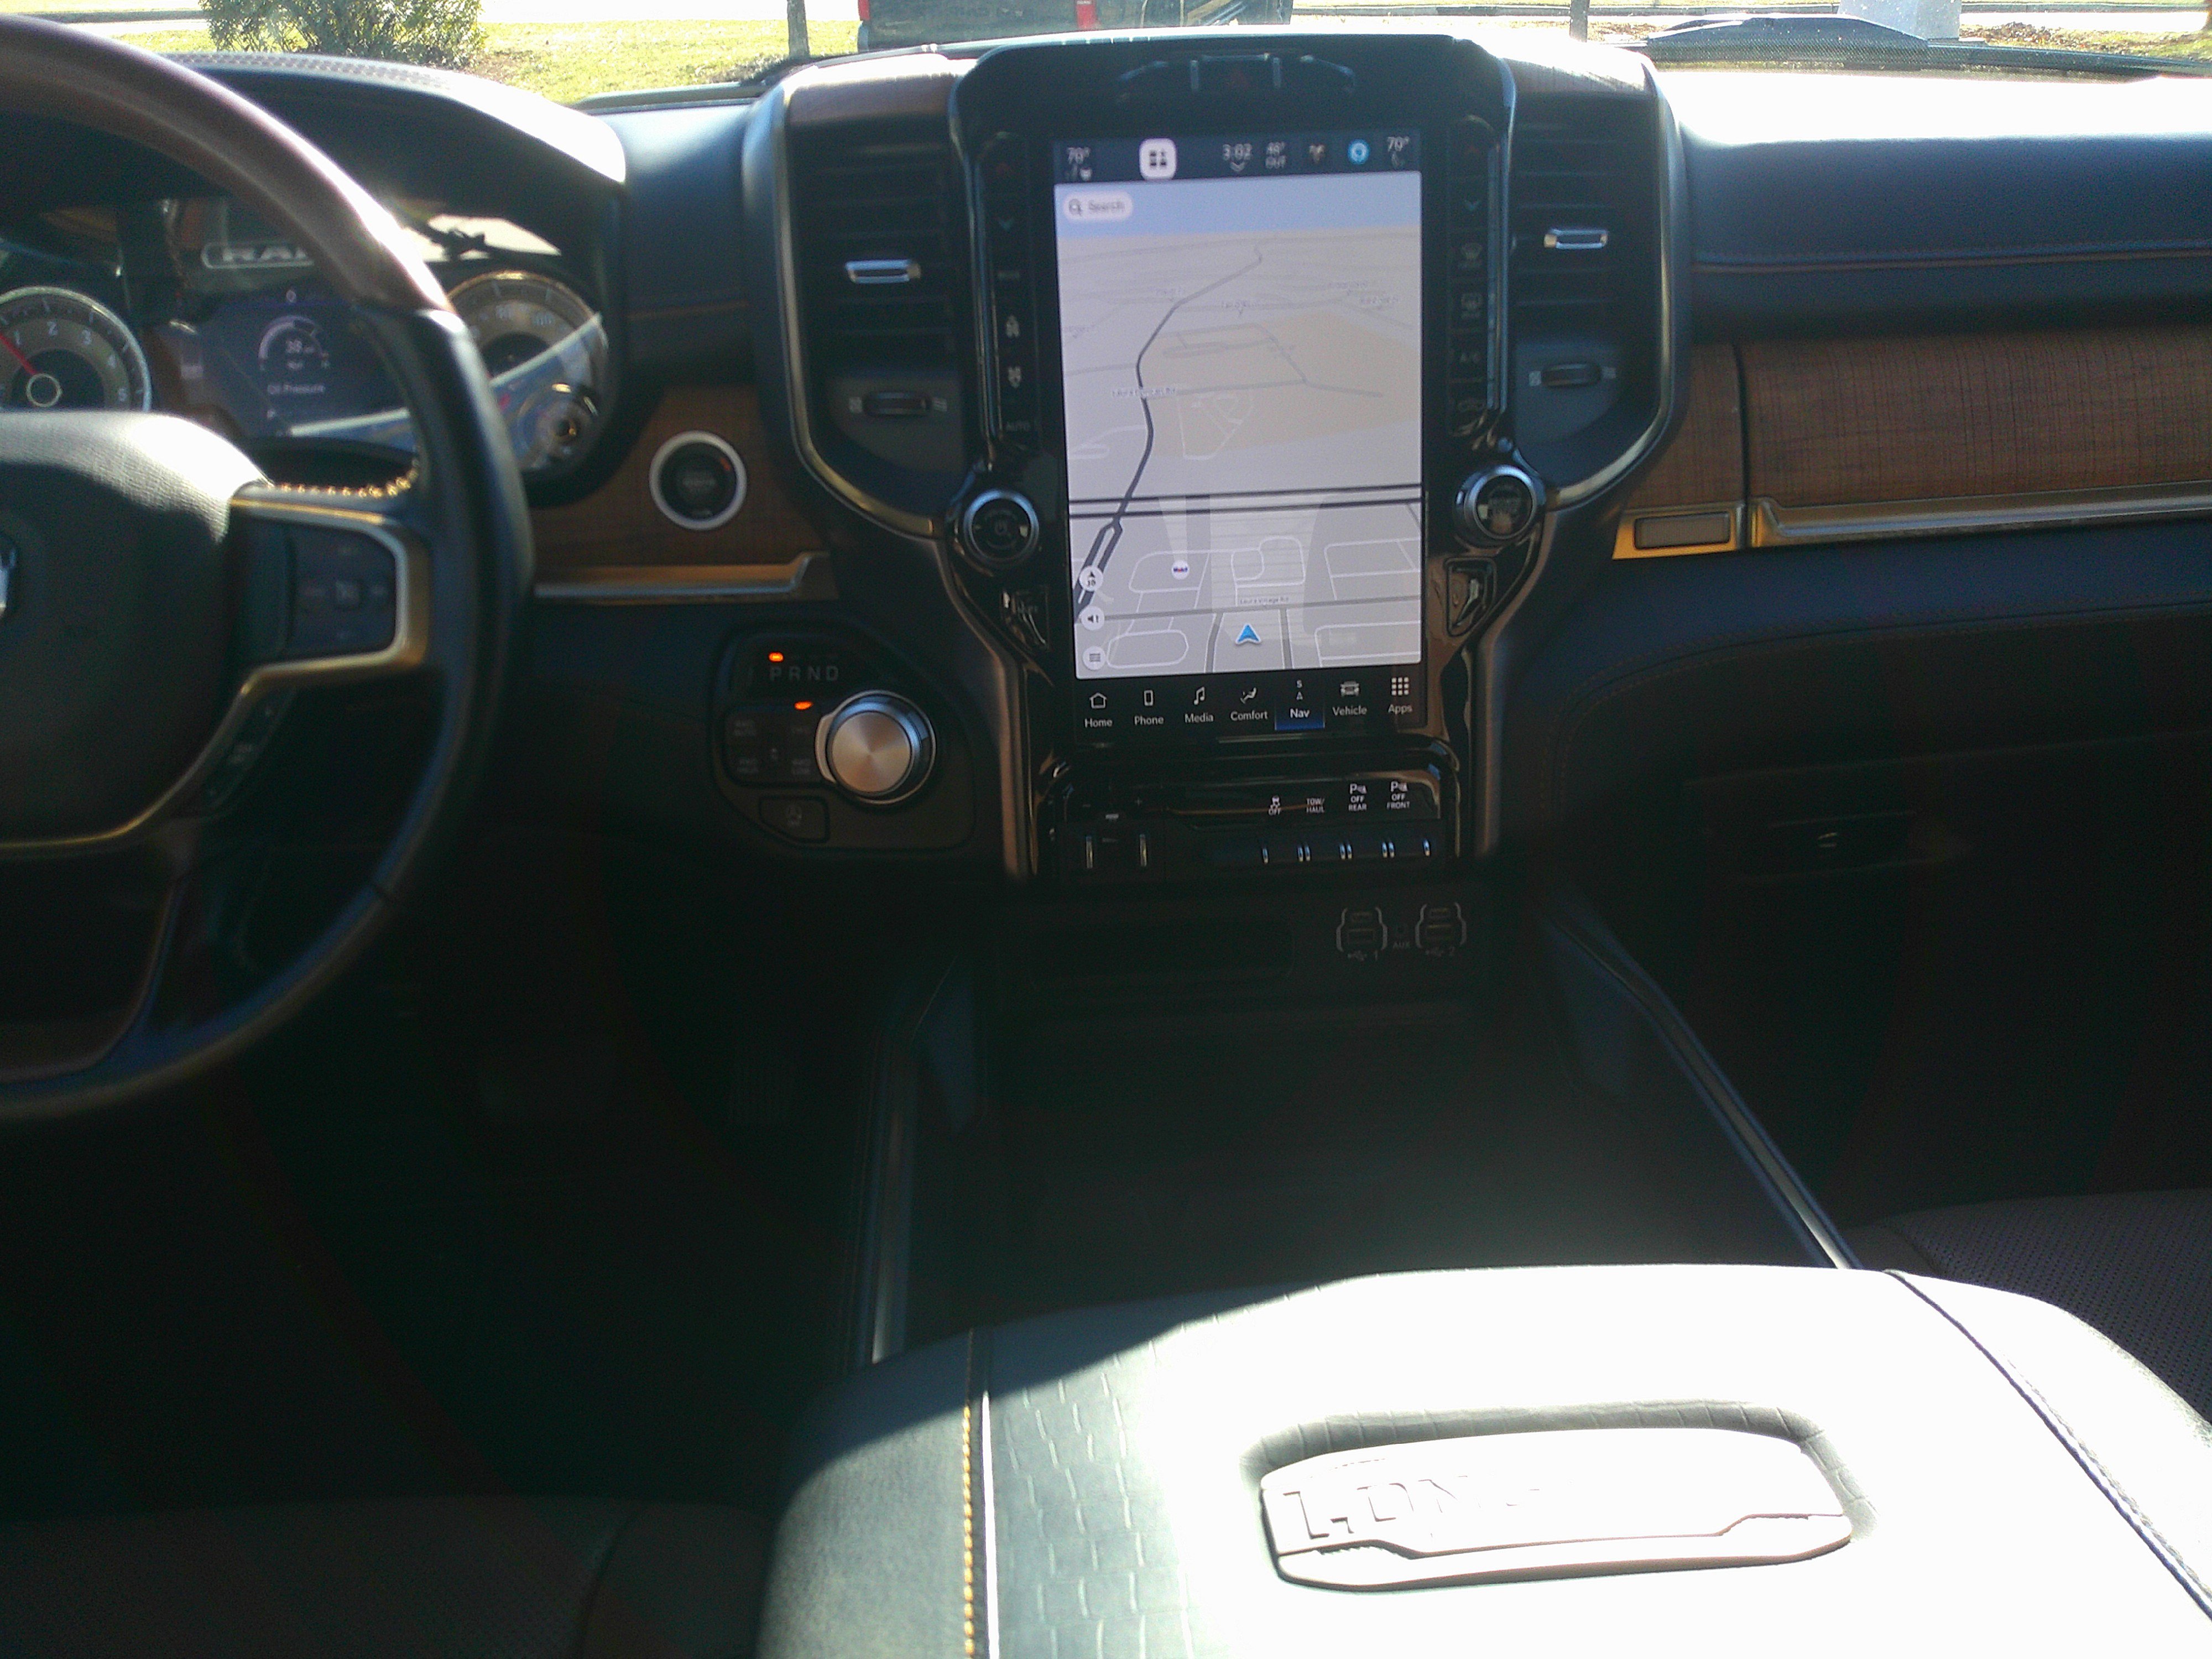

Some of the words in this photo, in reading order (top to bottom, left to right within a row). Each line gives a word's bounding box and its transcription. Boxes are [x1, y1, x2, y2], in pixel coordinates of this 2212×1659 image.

[1223, 143, 1252, 161] 3:02
[1290, 708, 1310, 718] Nav
[1332, 705, 1368, 716] Vehicle
[1388, 704, 1413, 715] Apps
[1134, 716, 1164, 725] Phone
[1185, 713, 1214, 723] Media
[1230, 710, 1268, 721] Comfort
[1084, 718, 1113, 728] Home
[1350, 795, 1365, 804] OFF
[1391, 793, 1406, 802] OFF
[1348, 803, 1367, 812] REAR
[1386, 801, 1410, 810] FRONT
